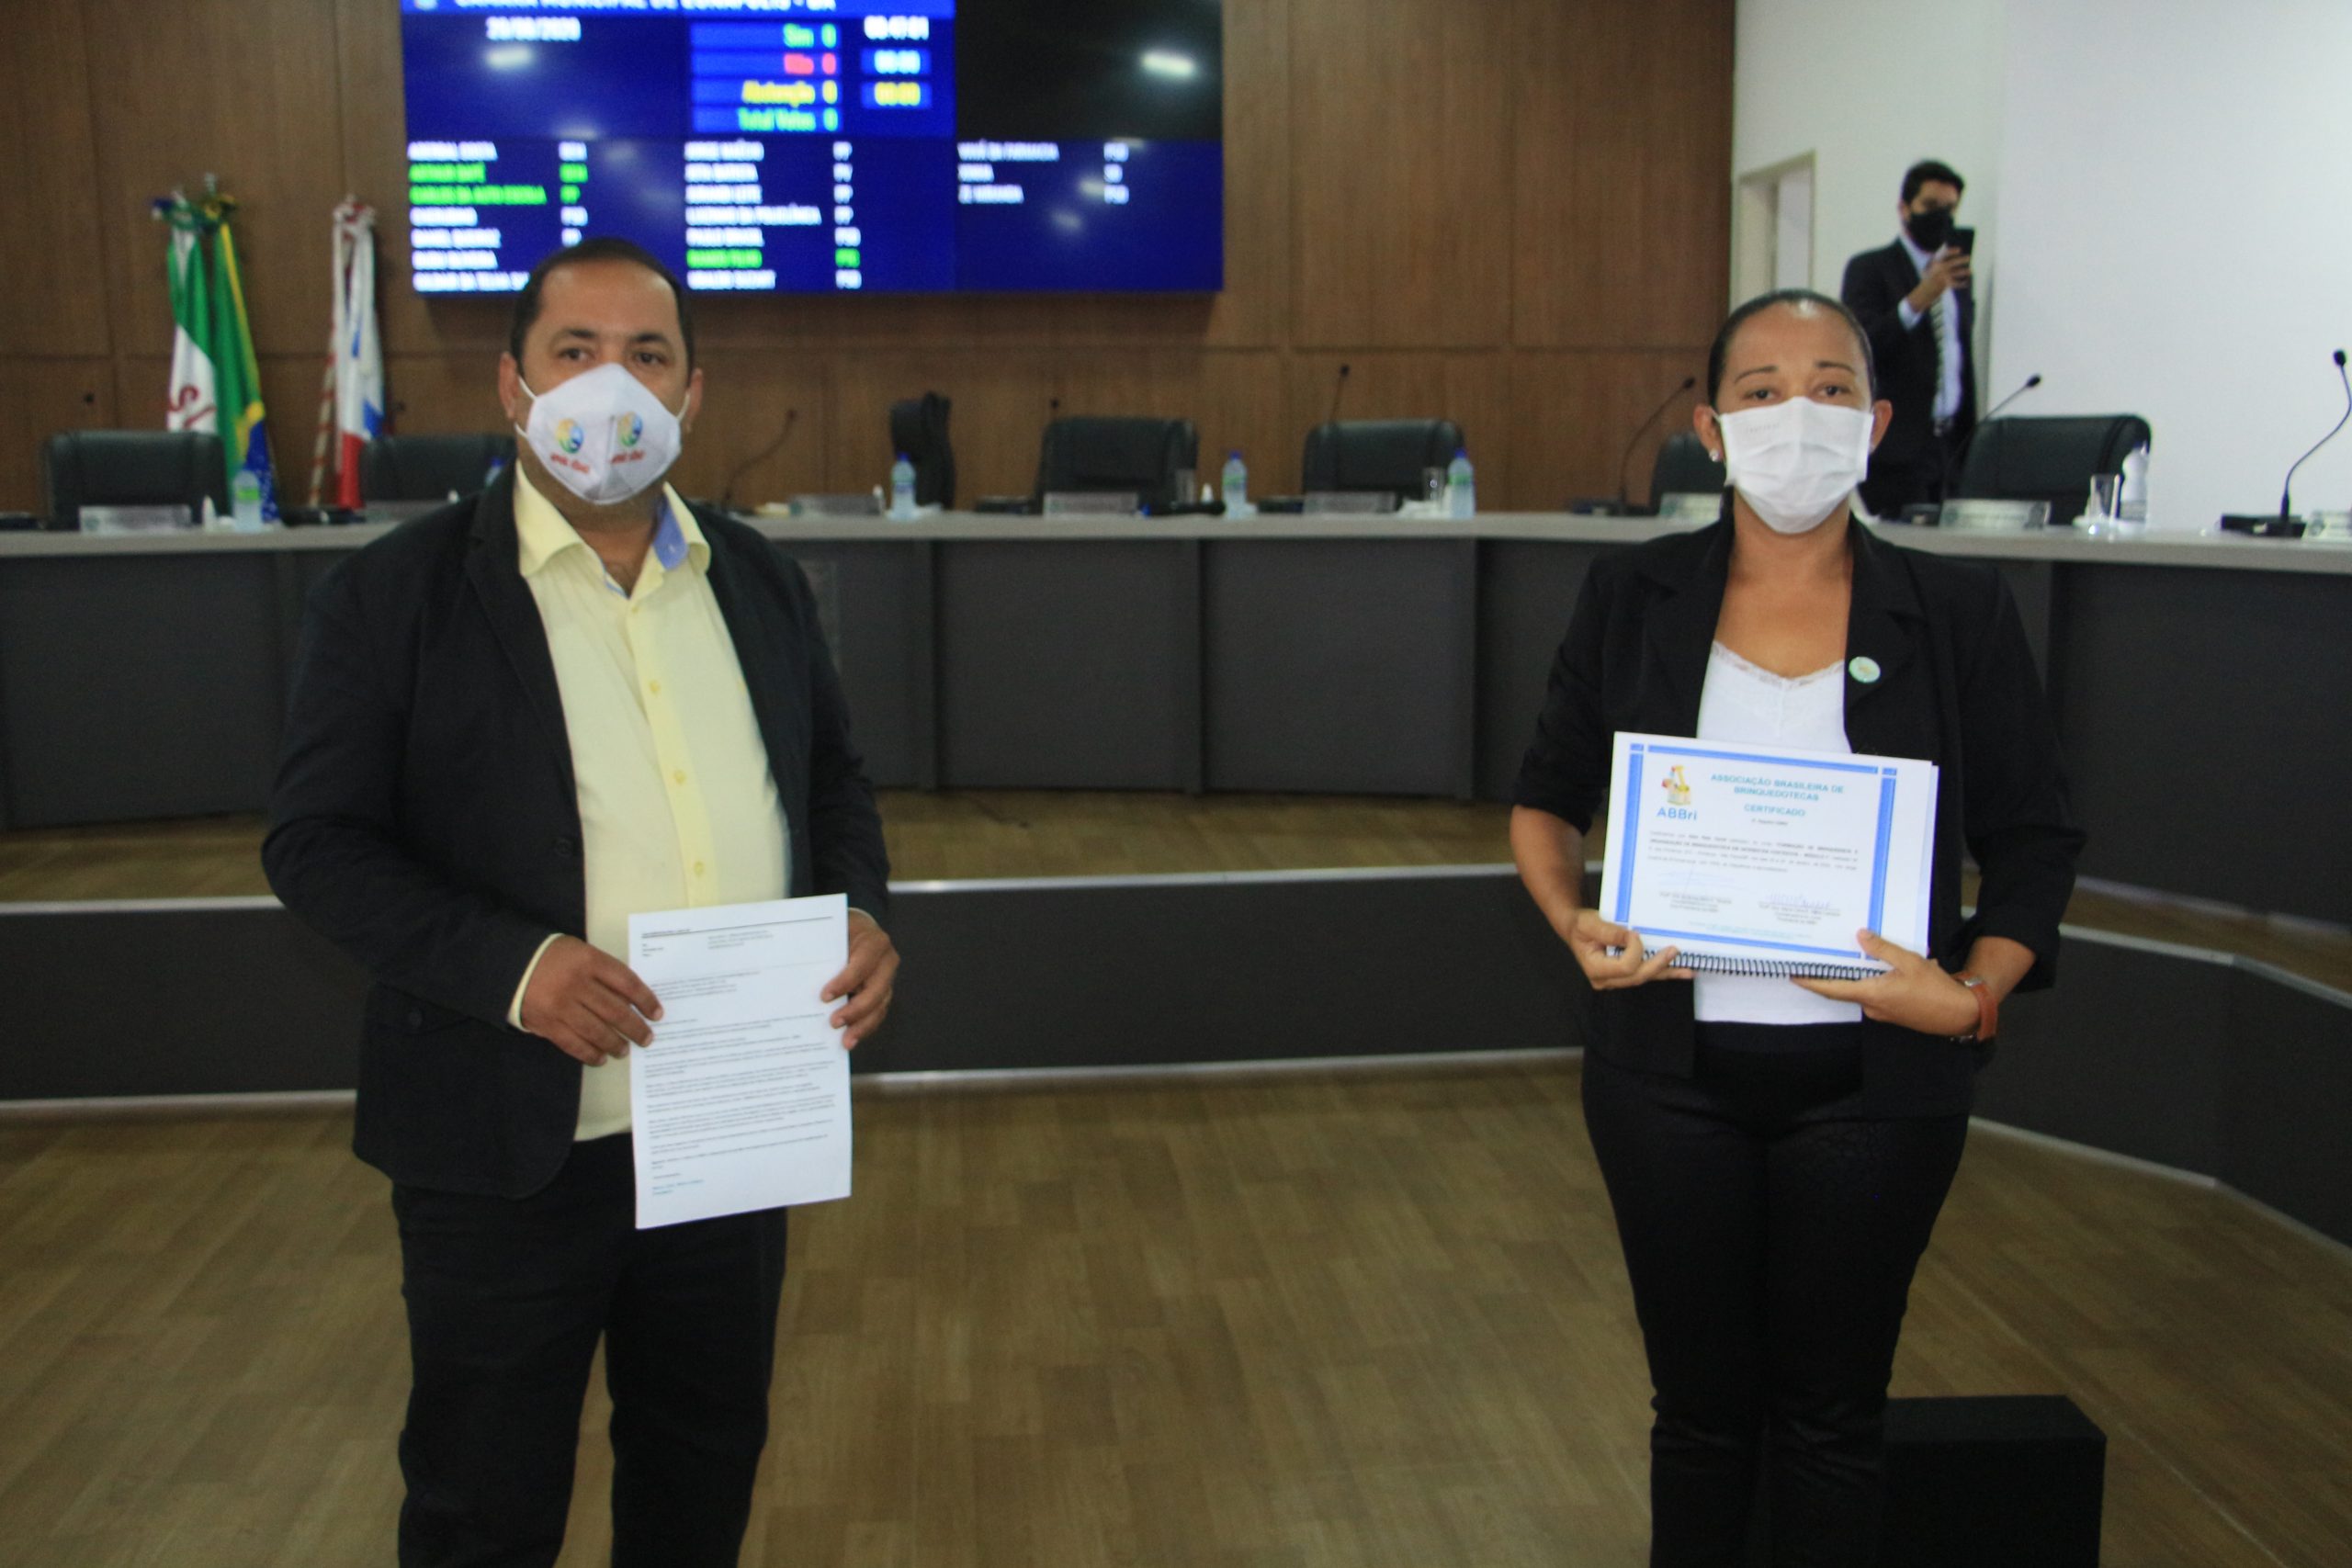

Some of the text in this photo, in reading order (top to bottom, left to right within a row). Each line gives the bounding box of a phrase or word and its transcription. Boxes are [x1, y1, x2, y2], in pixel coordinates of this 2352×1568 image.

[784, 23, 814, 48] Sim
[1711, 773, 1844, 794] ASSOCIAÇÃO BRASILEIRA DE
[1734, 786, 1819, 802] BRINQUEDOTECAS
[1657, 807, 1698, 821] ABBri
[1744, 804, 1805, 817] CERTIFICADO
